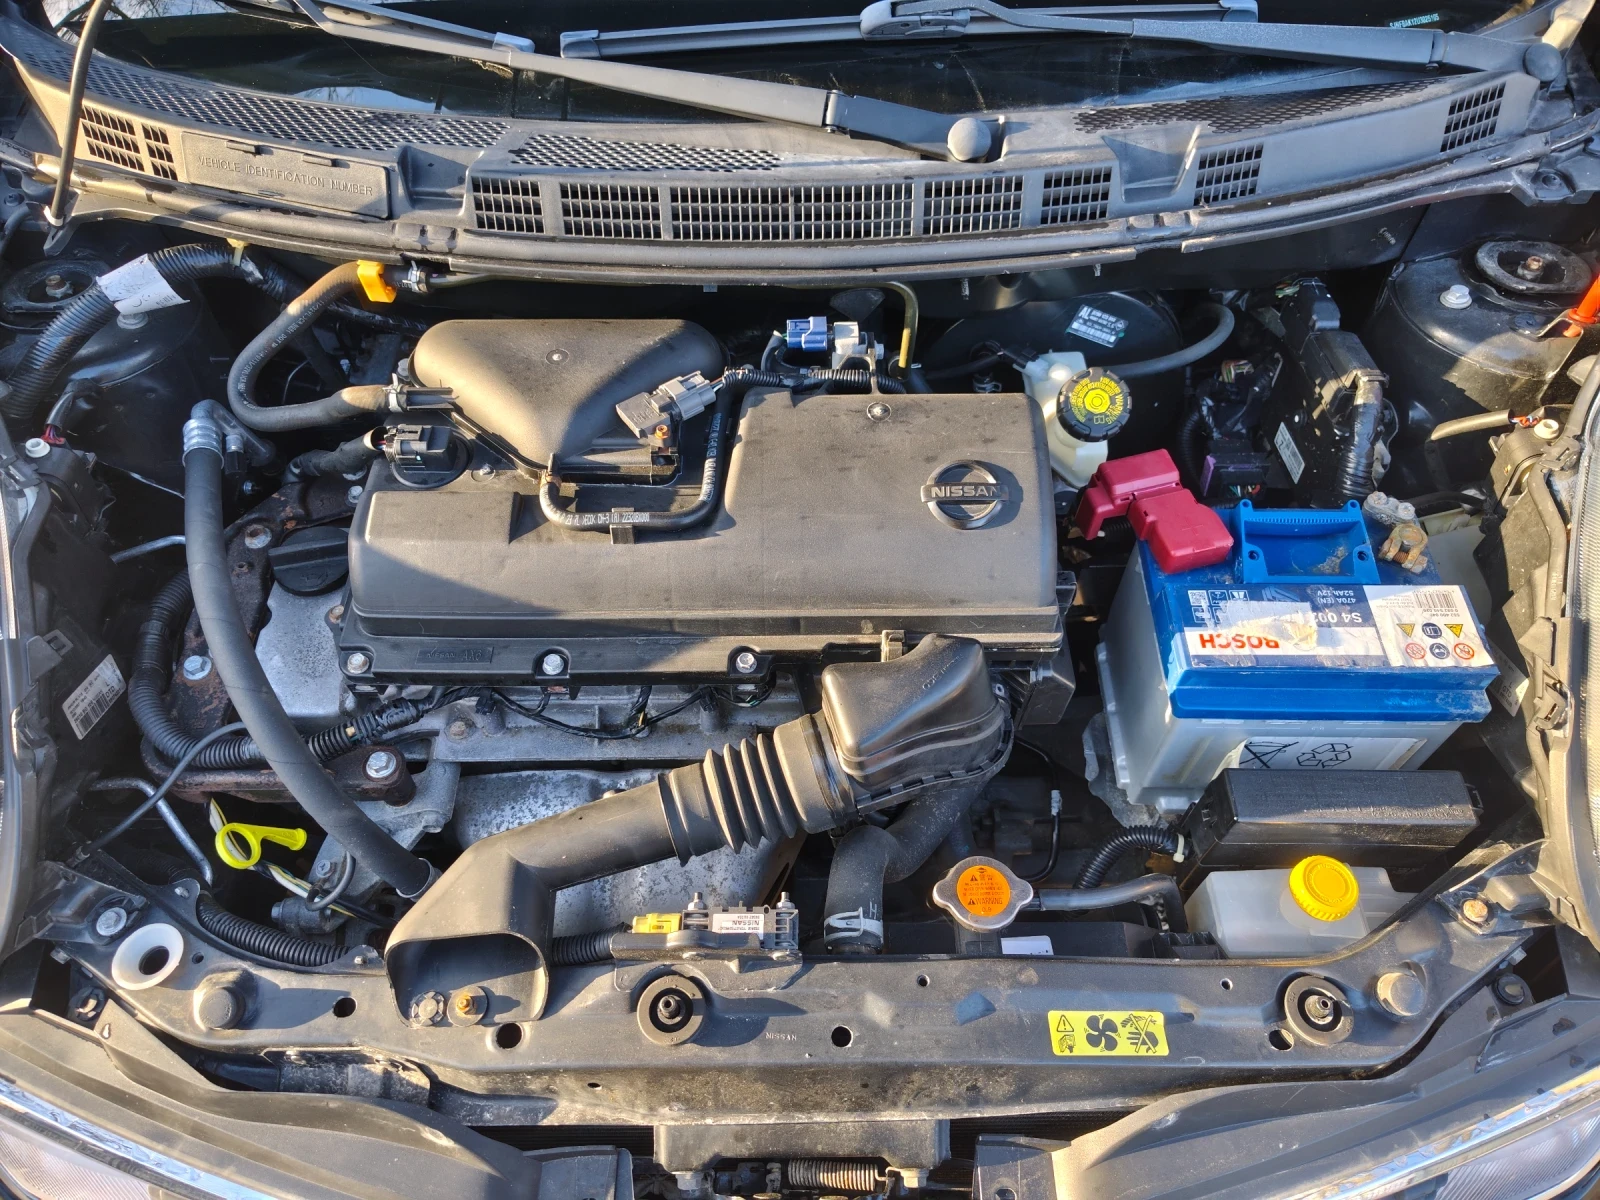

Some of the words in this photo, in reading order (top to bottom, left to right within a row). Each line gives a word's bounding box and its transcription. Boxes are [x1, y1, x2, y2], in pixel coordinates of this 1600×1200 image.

[198, 156, 240, 172] VEHICLE
[246, 164, 324, 188] IDENTIFICATION
[330, 179, 372, 196] NUMBER
[930, 485, 1002, 498] NISSAN
[1341, 612, 1362, 623] S4
[1199, 634, 1280, 649] BOSCH
[766, 1032, 796, 1040] NISSAN
